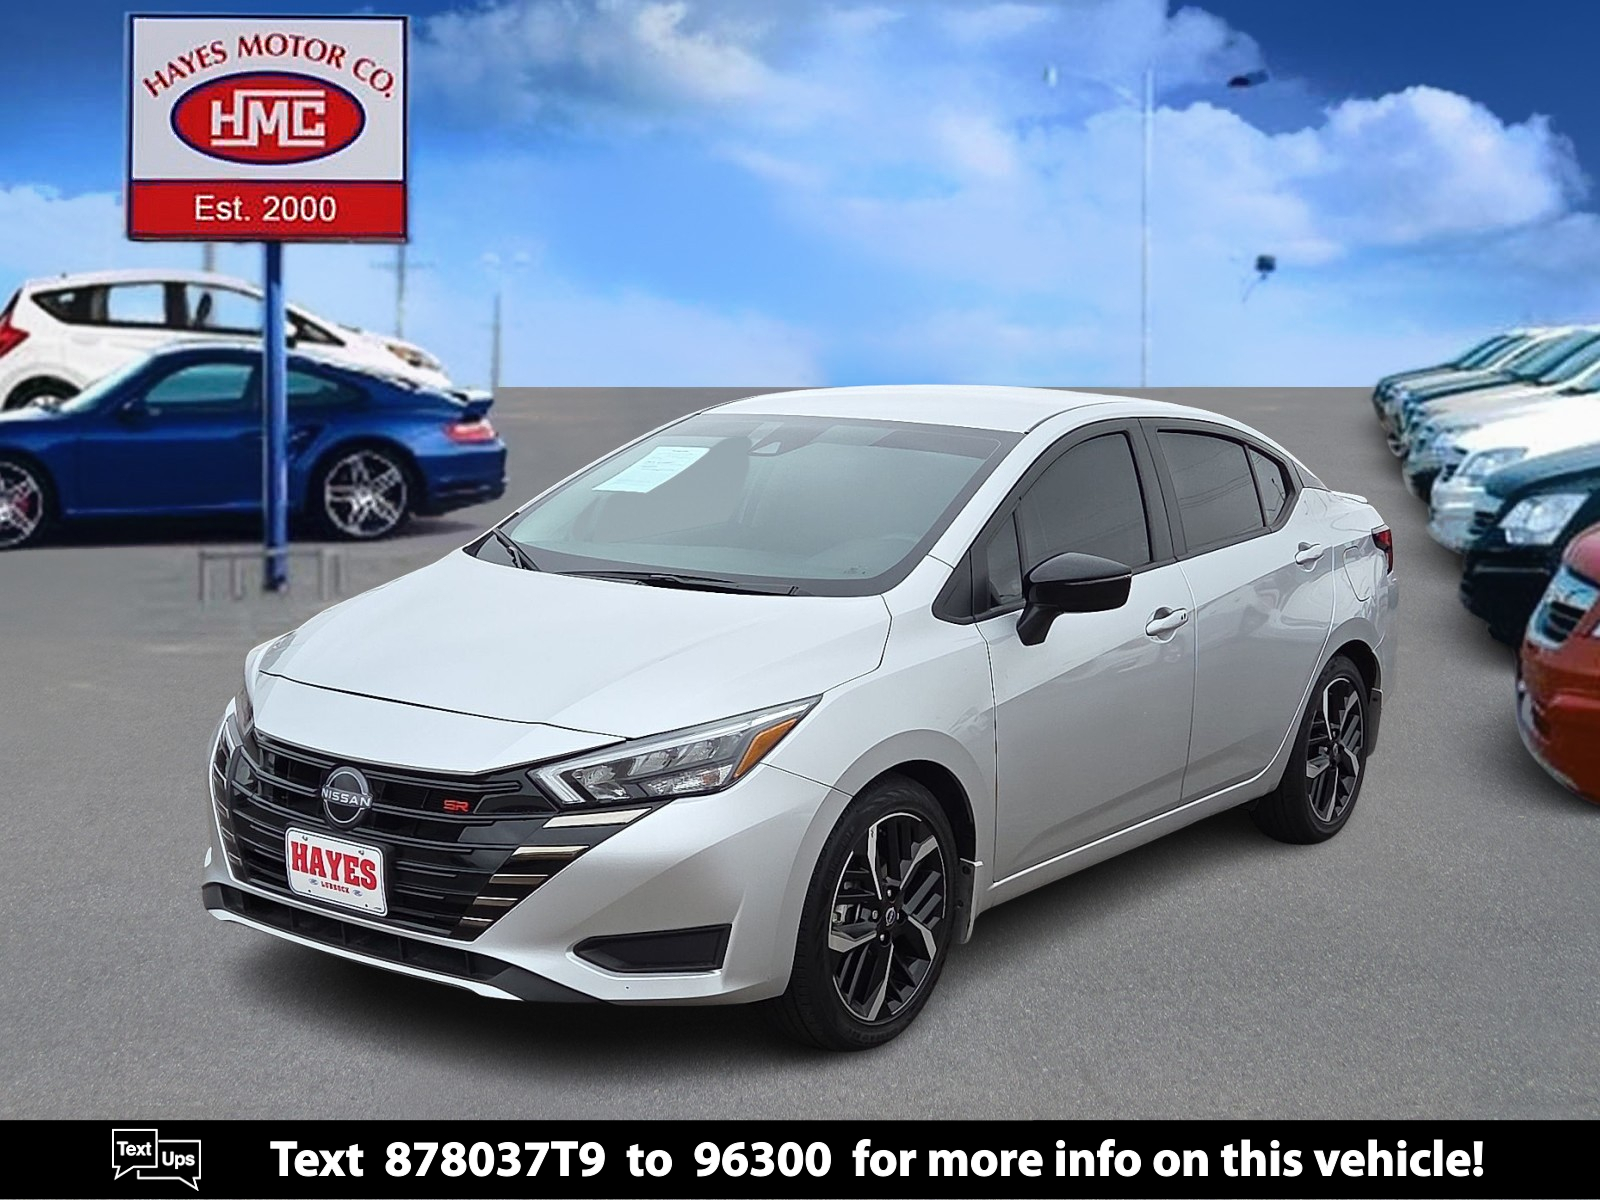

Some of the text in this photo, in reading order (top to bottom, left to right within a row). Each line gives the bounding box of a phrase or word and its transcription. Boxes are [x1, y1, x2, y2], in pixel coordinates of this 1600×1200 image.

[142, 33, 394, 98] HAYES MOTOR CO.
[210, 89, 326, 147] HMC
[194, 194, 337, 222] Est. 2000
[321, 788, 371, 807] NISSAN
[443, 800, 470, 812] SR
[290, 841, 377, 890] HAYES
